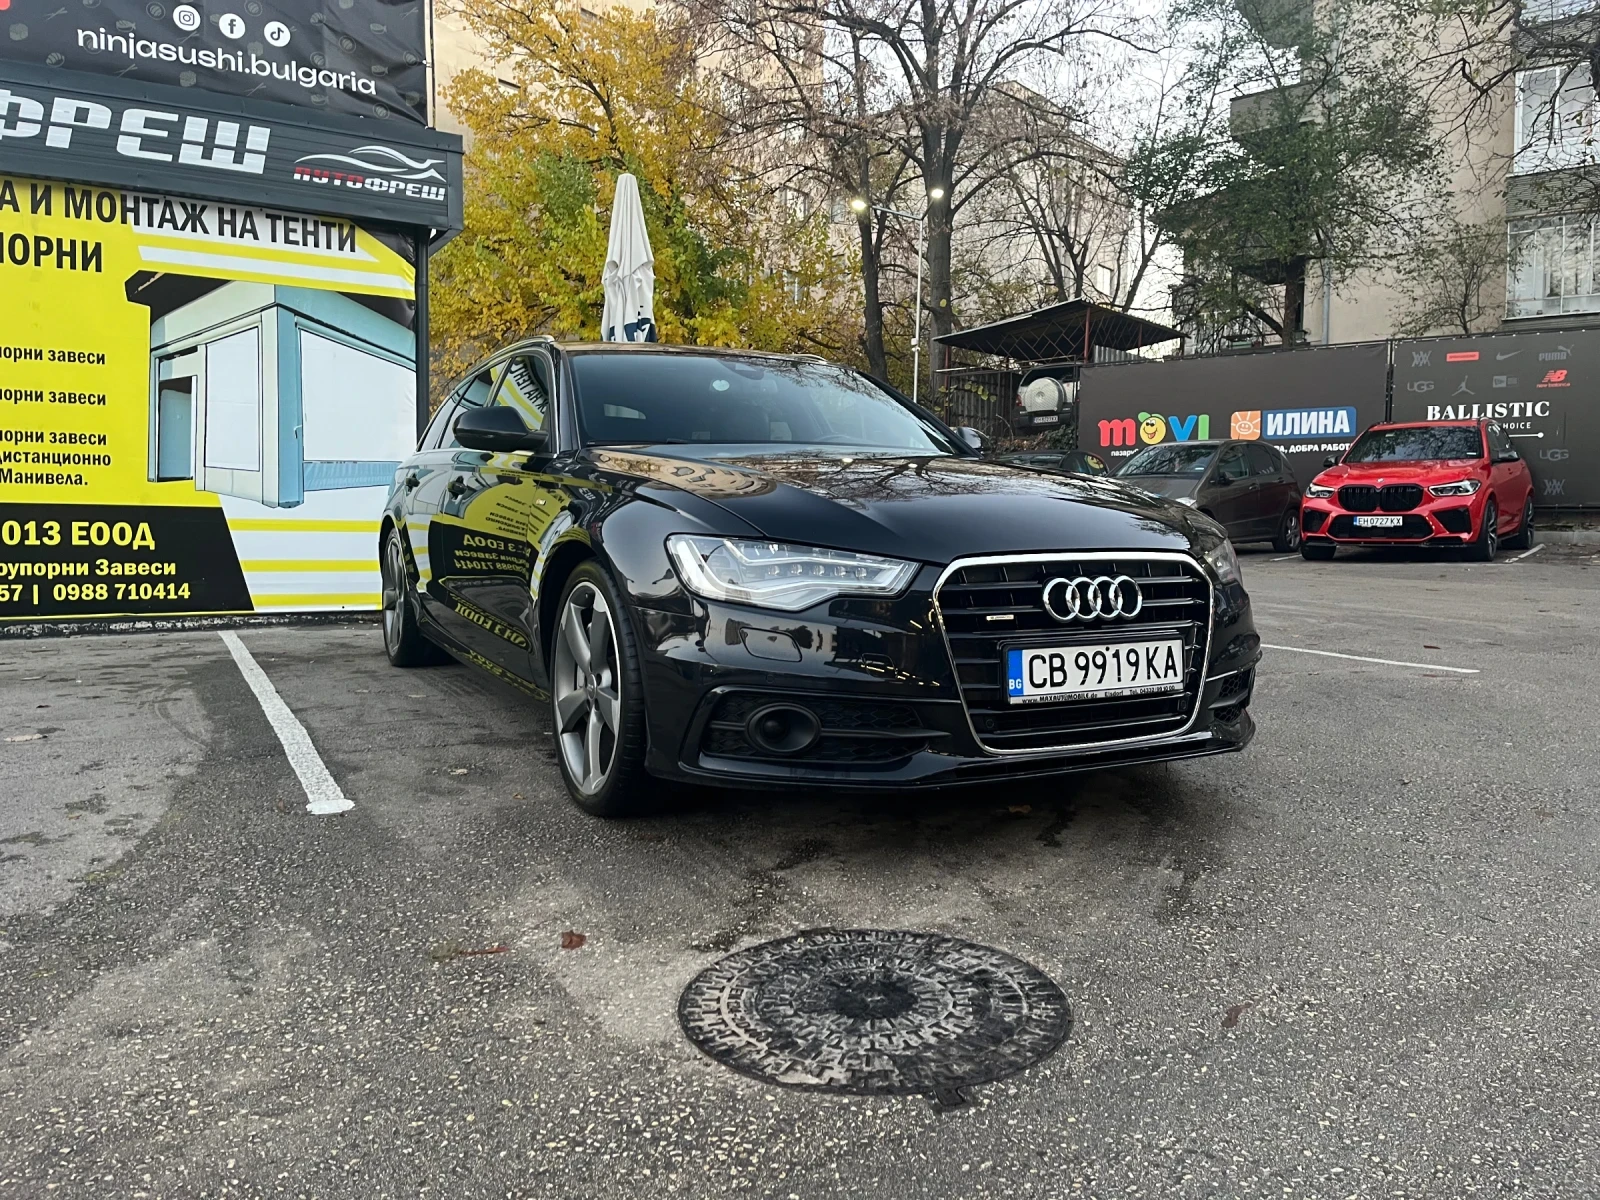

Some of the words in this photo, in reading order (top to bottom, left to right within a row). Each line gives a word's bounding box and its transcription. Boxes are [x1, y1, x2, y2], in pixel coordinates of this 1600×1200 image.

[77, 26, 376, 95] ninjasushi.bulgaria
[30, 183, 52, 216] И
[64, 187, 209, 234] МОНТАЖ
[218, 207, 259, 241] НА
[266, 213, 356, 252] ТЕНТИ
[0, 232, 102, 273] ОРНИ
[0, 346, 43, 362] орни
[48, 349, 105, 365] завеси
[1407, 381, 1434, 393] UGG
[0, 388, 43, 404] орни
[48, 391, 106, 406] завеси
[1427, 401, 1550, 421] BALLISTIC
[1267, 410, 1350, 436] ИЛИНА
[1502, 422, 1532, 430] HOICE
[0, 429, 44, 446] орни
[49, 432, 107, 446] завеси
[1288, 444, 1319, 454] ДОБРА
[1539, 448, 1569, 461] UGG
[0, 451, 111, 467] истанционно
[71, 521, 155, 550] ЕООД
[95, 559, 176, 575] Завеси
[53, 583, 108, 601] 0988
[114, 582, 190, 600] 710414
[1027, 652, 1068, 689] CB
[1075, 649, 1140, 685] 9919
[1147, 645, 1179, 680] KA
[1008, 678, 1022, 690] BG
